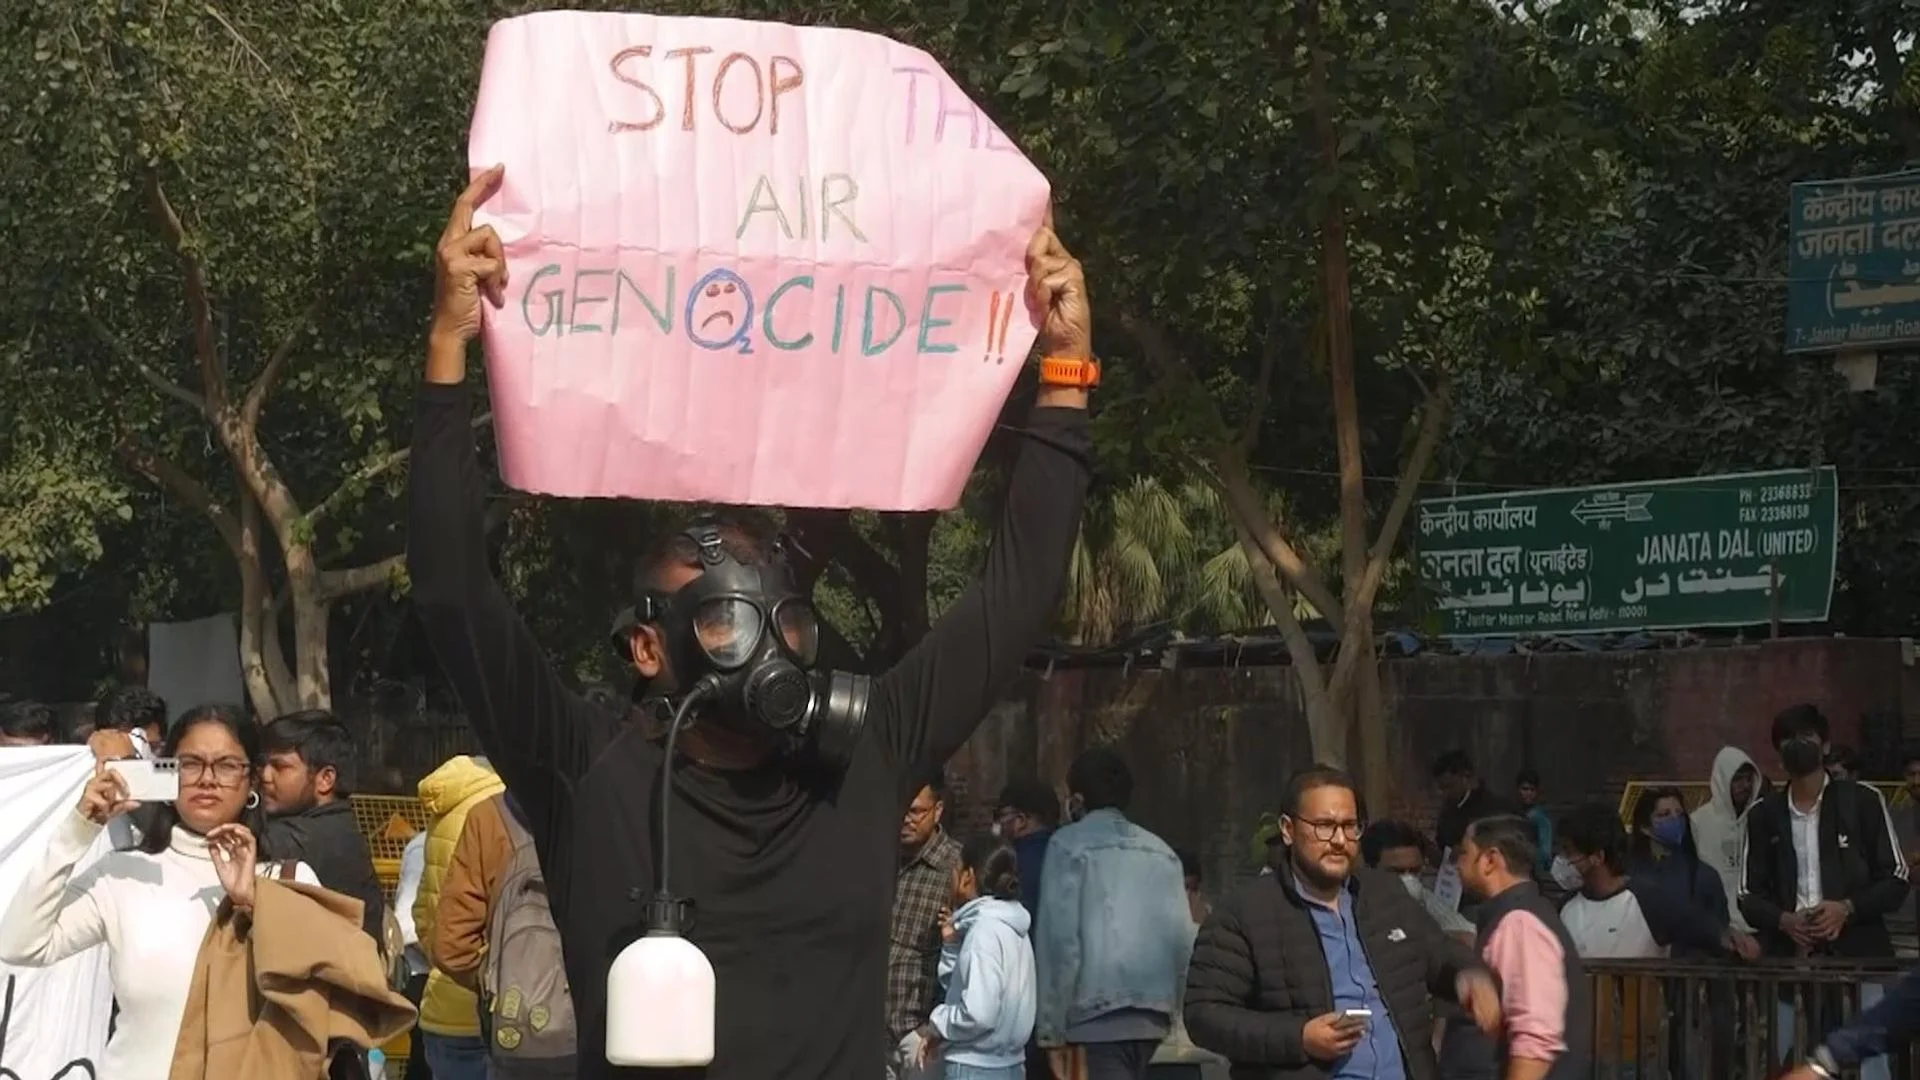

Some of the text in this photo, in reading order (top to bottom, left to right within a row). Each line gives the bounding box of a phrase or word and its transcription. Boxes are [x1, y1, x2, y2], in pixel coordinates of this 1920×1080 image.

[608, 45, 804, 136] STOP
[735, 172, 868, 244] AIR
[1796, 222, 1875, 260] जनता
[1419, 498, 1537, 538] केन्द्रीय कार्यालय
[1486, 545, 1522, 578] दल
[1636, 524, 1819, 566] JANATA DAL (UNITED)
[1499, 611, 1535, 626] Mantar
